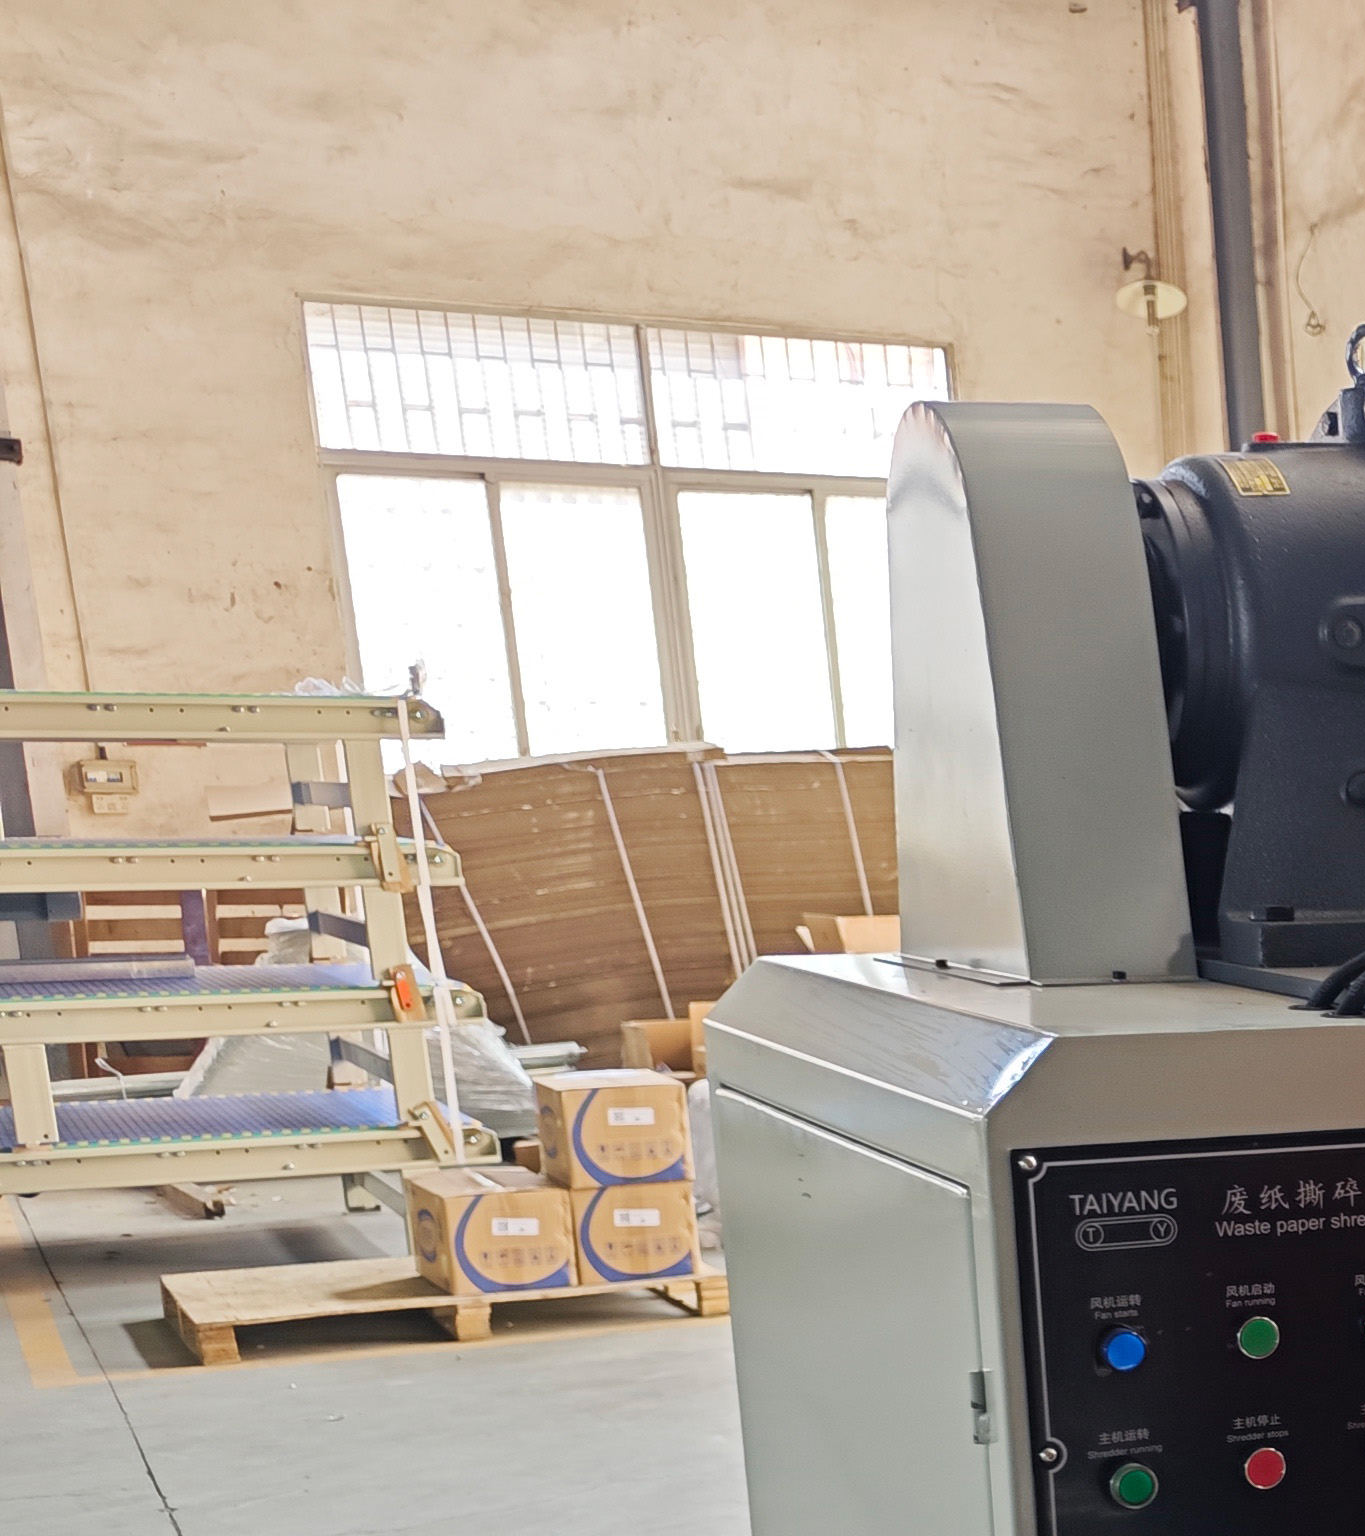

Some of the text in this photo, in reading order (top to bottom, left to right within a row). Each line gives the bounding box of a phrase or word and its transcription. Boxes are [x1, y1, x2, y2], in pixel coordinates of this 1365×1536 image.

[1069, 1188, 1178, 1216] TAIYANG
[1215, 1221, 1271, 1238] Waste
[1276, 1215, 1325, 1236] paper
[1225, 1282, 1276, 1298] 风机启动
[1089, 1293, 1142, 1311] 风机运转
[1226, 1296, 1276, 1309] Fan running
[1094, 1307, 1139, 1320] Fan starts
[1232, 1414, 1282, 1430] 主机停止
[1098, 1427, 1151, 1446] 主机运转
[1226, 1427, 1289, 1444] Shredder stops
[1087, 1442, 1164, 1460] Shredder running
